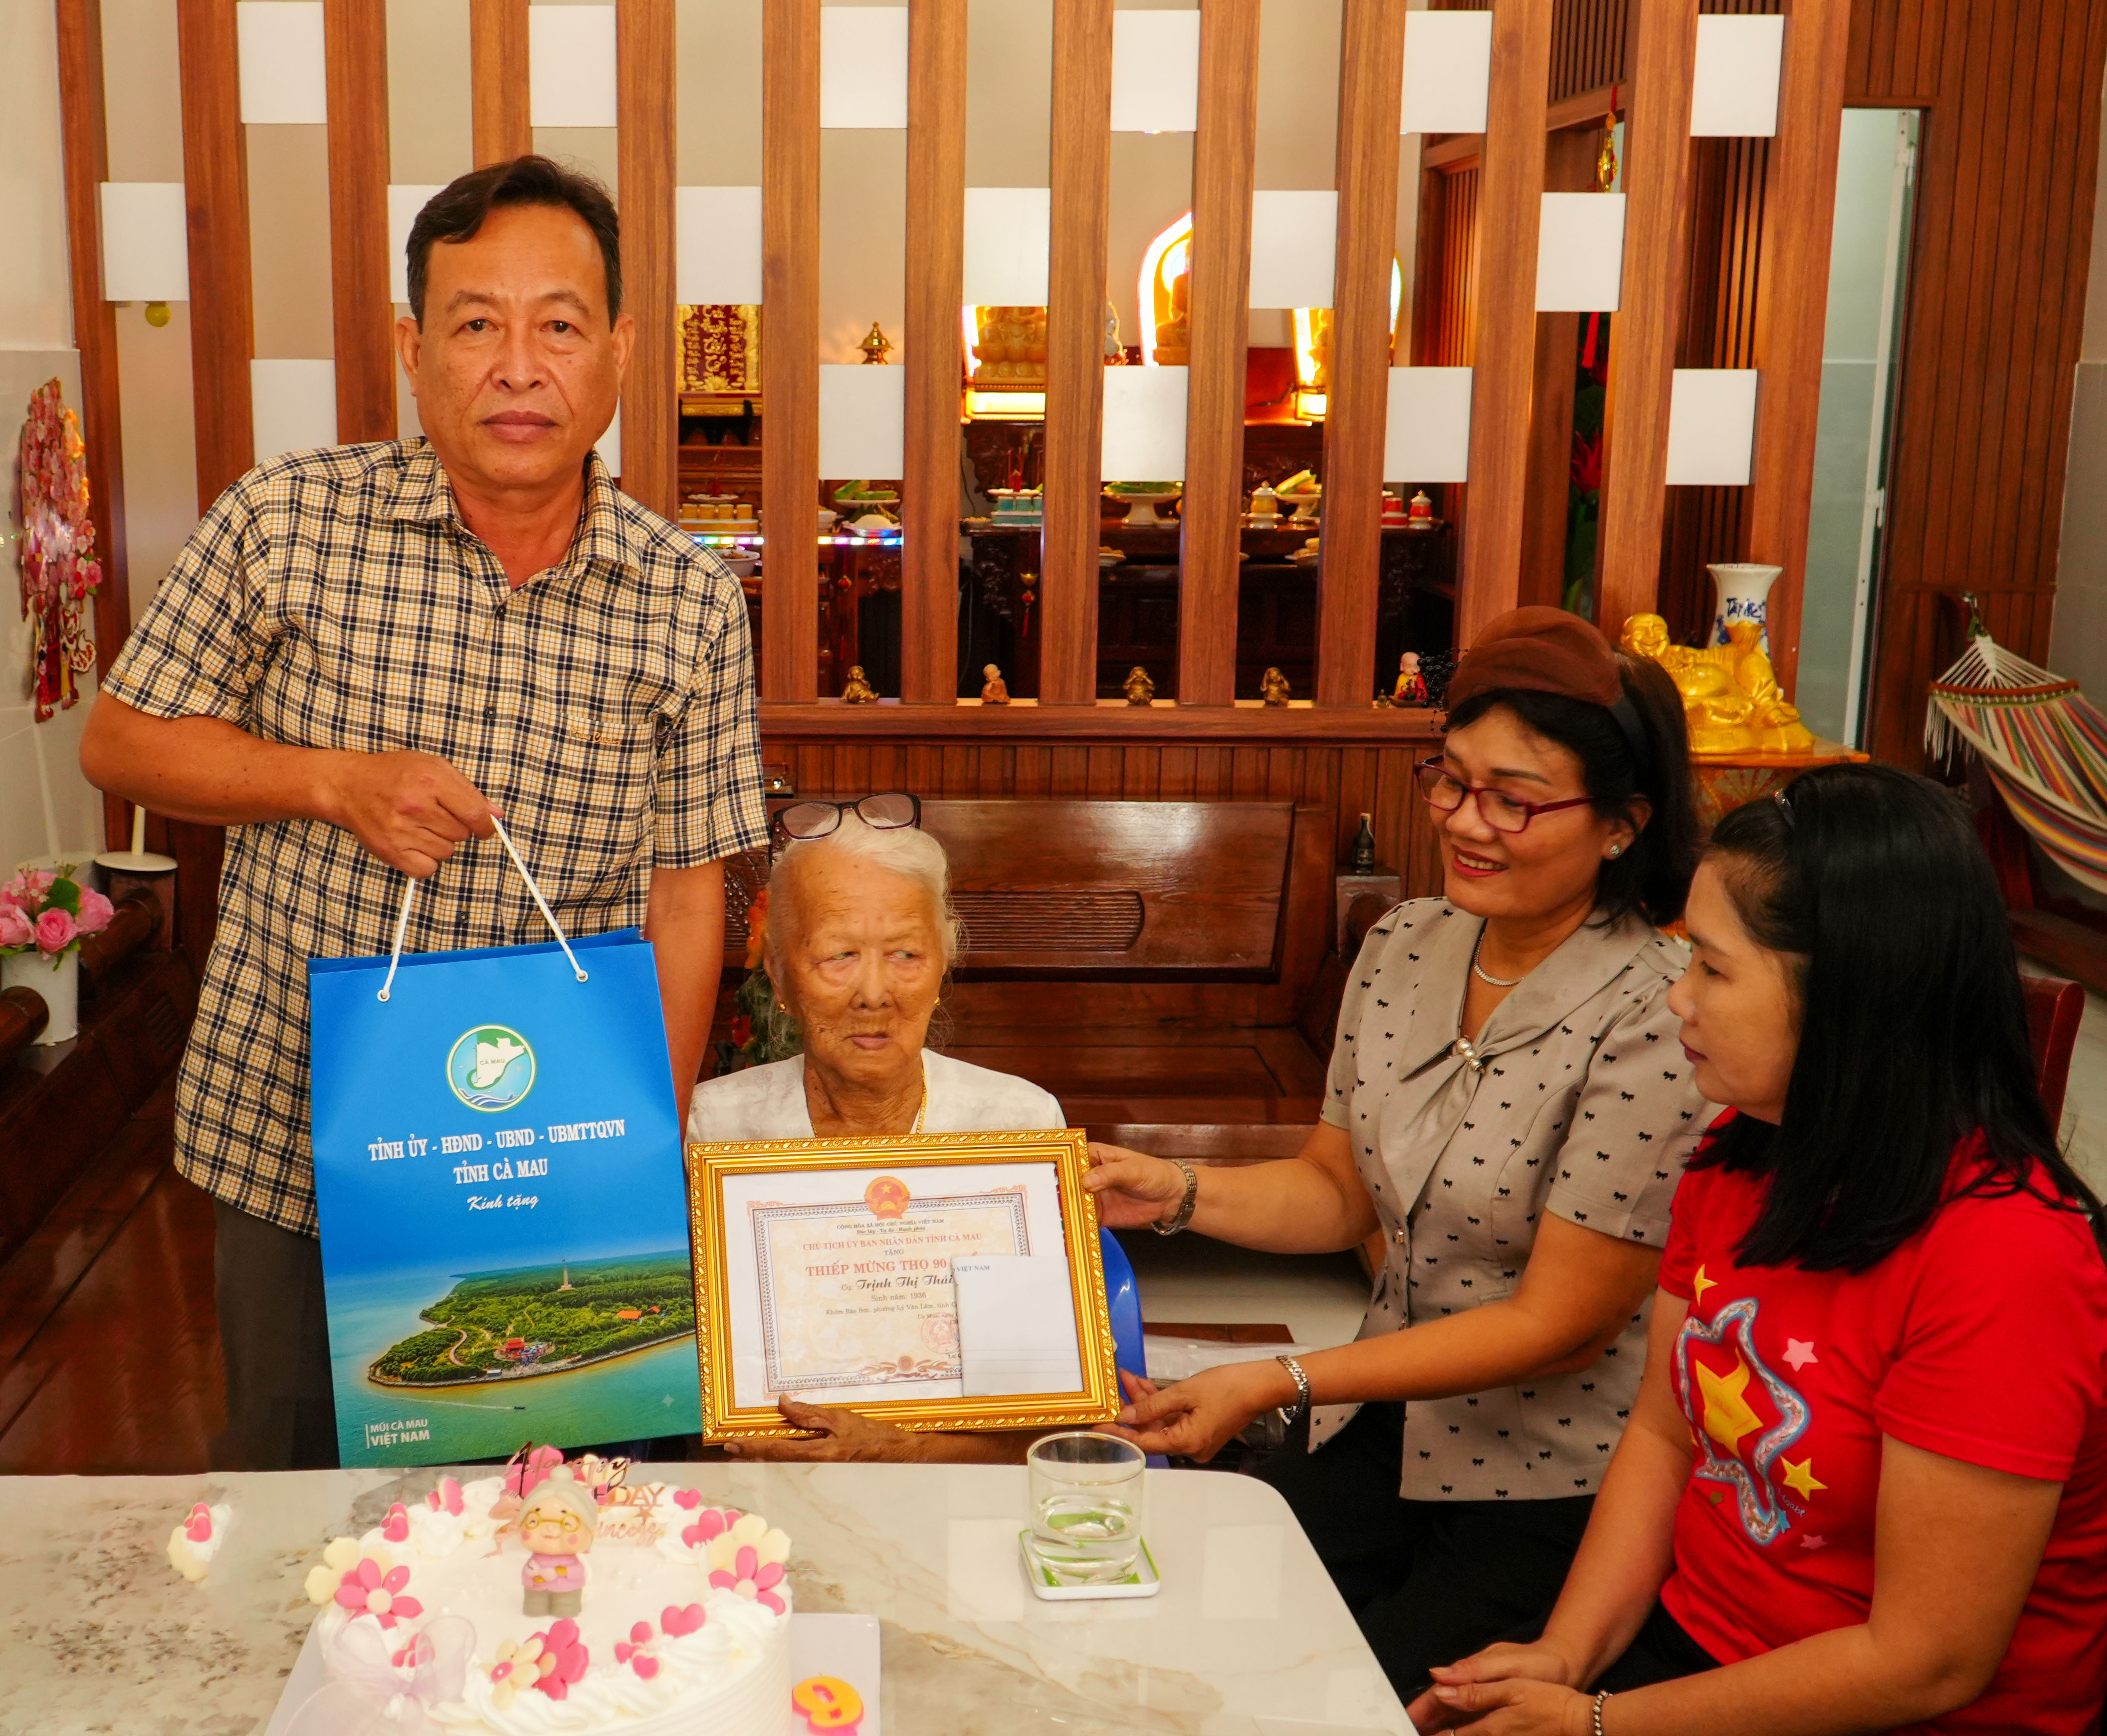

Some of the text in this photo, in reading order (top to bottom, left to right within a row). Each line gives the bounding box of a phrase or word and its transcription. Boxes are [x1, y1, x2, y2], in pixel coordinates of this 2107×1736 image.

[368, 1137, 404, 1161] TỈNH
[408, 1133, 428, 1157] ỦY
[441, 1133, 482, 1154] HĐND
[495, 1128, 535, 1148] UBND
[548, 1119, 626, 1143] UBMTTQVN
[453, 1157, 548, 1184] TỈNH CÀ MAU
[467, 1194, 539, 1211] Kính tặng
[823, 1241, 844, 1251] TỊCH
[880, 1236, 903, 1246] NHÂN
[906, 1234, 923, 1244] DÂN
[806, 1259, 946, 1277] THIẾP MỪNG THỌ 90
[856, 1278, 892, 1291] Trịnh
[896, 1277, 918, 1289] Thị
[391, 1420, 404, 1430] CÀ
[406, 1419, 428, 1429] MAU
[371, 1429, 430, 1448] VIỆT NAM
